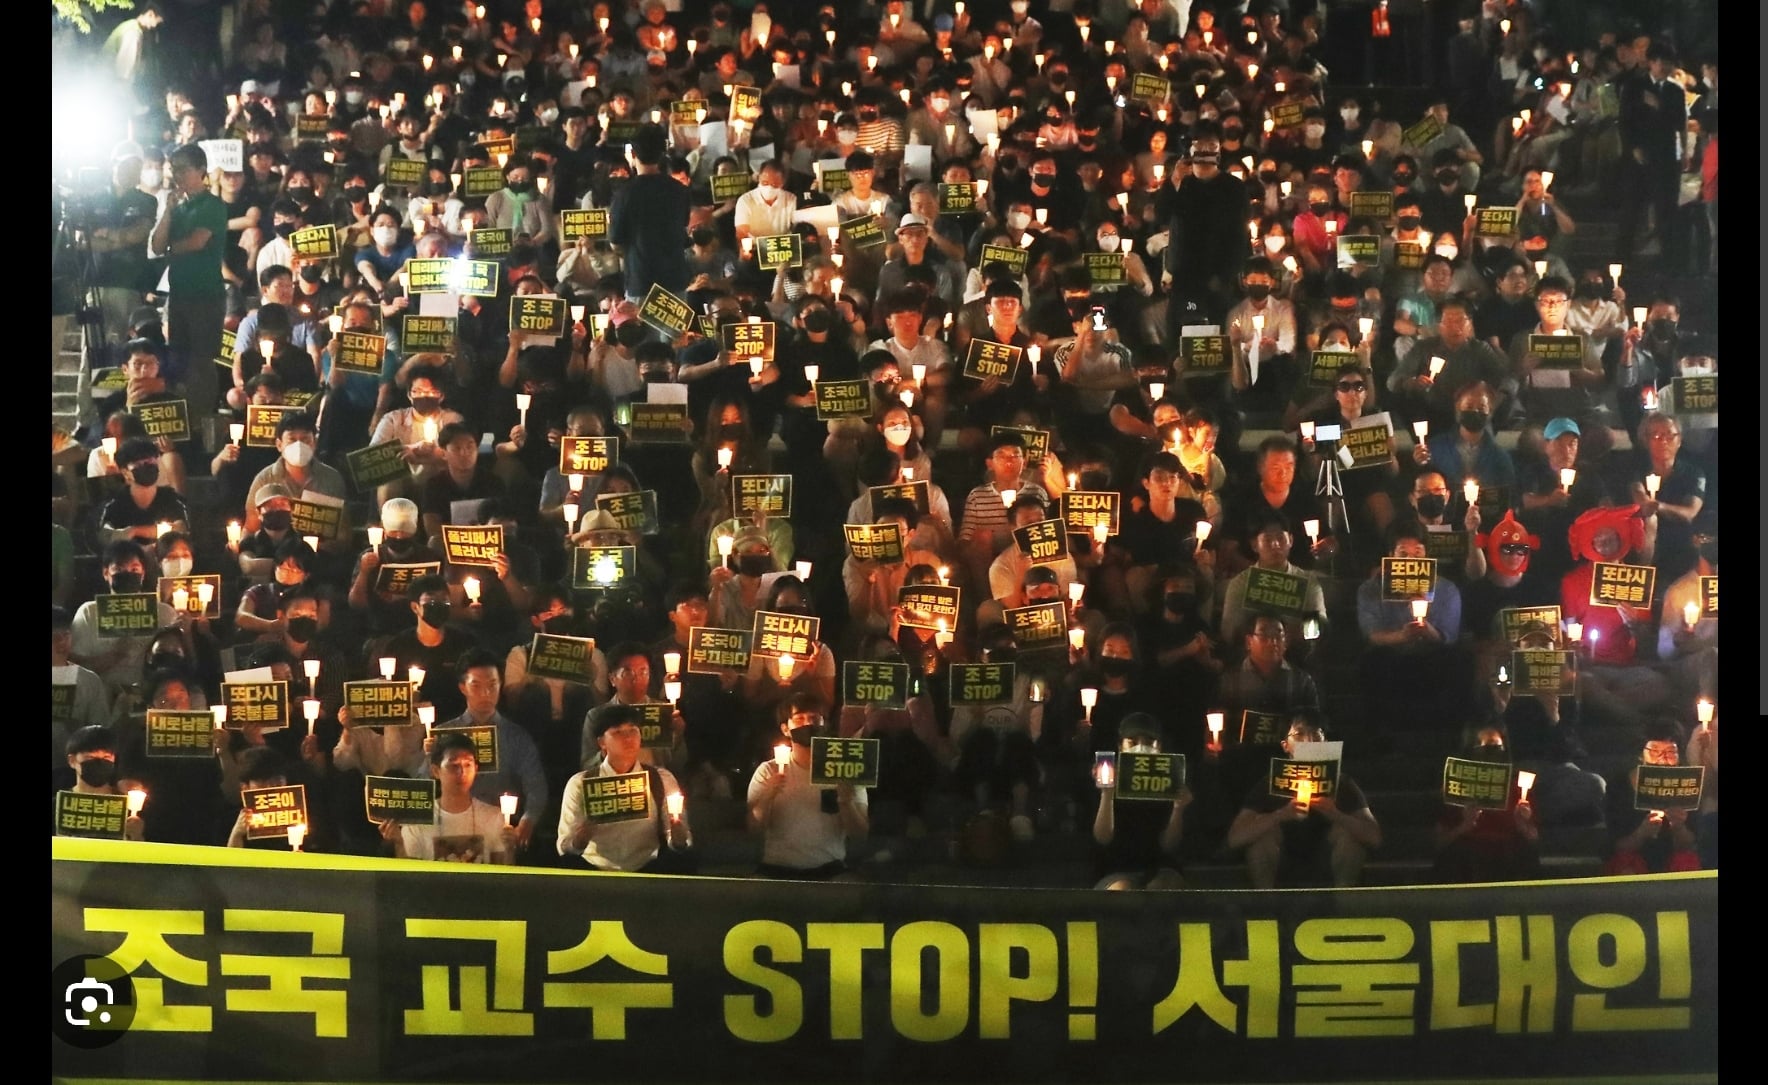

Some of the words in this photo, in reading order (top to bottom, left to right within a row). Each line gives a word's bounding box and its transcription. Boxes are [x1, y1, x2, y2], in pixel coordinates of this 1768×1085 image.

[947, 197, 972, 208] STOP
[565, 213, 604, 223] 서울대인
[1482, 212, 1512, 222] 또다시
[295, 228, 329, 242] 또다시
[476, 232, 506, 243] 조국이
[766, 237, 792, 250] 조국
[767, 251, 793, 263] STOP
[1089, 256, 1121, 266] 또다시
[523, 300, 553, 314] 조국
[656, 292, 687, 320] 조국이
[408, 319, 454, 332] 폴리페서
[520, 315, 553, 330] STOP
[644, 302, 687, 333] 부끄럽다
[735, 326, 763, 340] 조국
[343, 338, 379, 351] 또다시
[735, 340, 764, 356] STOP
[980, 343, 1011, 360] 조국
[1192, 338, 1223, 352] 조국
[977, 359, 1007, 375] STOP
[1191, 353, 1223, 366] STOP
[824, 386, 860, 398] 조국이
[820, 399, 868, 413] 부끄럽다
[1684, 394, 1717, 408] STOP
[140, 405, 177, 420] 조국이
[258, 411, 282, 424] 조국
[145, 420, 184, 434] 끄럽다
[575, 440, 606, 454] 조국
[1352, 442, 1388, 458] 러나라
[572, 457, 608, 471] STOP
[742, 478, 784, 495] 또다시
[609, 494, 643, 512] 조국
[1069, 494, 1112, 511] 또다시
[1069, 511, 1112, 528] 촛불을
[448, 530, 498, 545] 폴리페서
[848, 527, 897, 544] 내로남불
[1028, 523, 1056, 541] 조국
[851, 543, 900, 559] 표리부동
[1030, 540, 1059, 559] STOP
[587, 567, 623, 581] SP
[1390, 560, 1431, 577] 또다시
[1602, 566, 1646, 585] 또다시
[1258, 573, 1297, 593] 조국이
[1391, 578, 1429, 593] 촛불을
[1600, 584, 1645, 602] 촛불을
[106, 598, 146, 612] 조국이
[100, 615, 156, 629] 부끄럽다
[1016, 608, 1055, 626] 조국이
[763, 615, 810, 636] 또다시
[701, 632, 743, 648] 조국이
[761, 633, 808, 654] 촛불을
[544, 640, 586, 658] 조국이
[693, 648, 748, 666] 부끄럽다
[857, 665, 894, 682] 조국
[964, 667, 1001, 682] 조국
[230, 686, 278, 702] 또다시
[349, 686, 410, 702] 폴리페서
[856, 684, 895, 700] STOP
[963, 683, 1002, 699] STOP
[231, 704, 278, 721] 촛불을
[349, 703, 409, 718] 물러나라
[151, 716, 212, 732] 내로남불
[151, 734, 212, 748] 표리부동
[826, 741, 865, 759] 조국
[824, 760, 865, 778] STOP
[1134, 757, 1170, 773] 조국
[1282, 764, 1327, 779] 조국이
[1449, 764, 1507, 784] 내로남불
[588, 776, 646, 799] 내로남불
[1131, 776, 1171, 792] STOP
[1447, 780, 1505, 800] 표리부동
[63, 798, 124, 813] 내로남불
[255, 791, 295, 810] 조국이
[407, 800, 433, 810] 못한다
[590, 794, 646, 816] 표리부동
[61, 816, 121, 832] 표리부동
[249, 809, 303, 827] 부끄럽다
[83, 907, 351, 1038] 조국
[404, 918, 674, 1040] 교수
[723, 919, 1098, 1043] STOP!
[1153, 911, 1692, 1039] 서울대인
